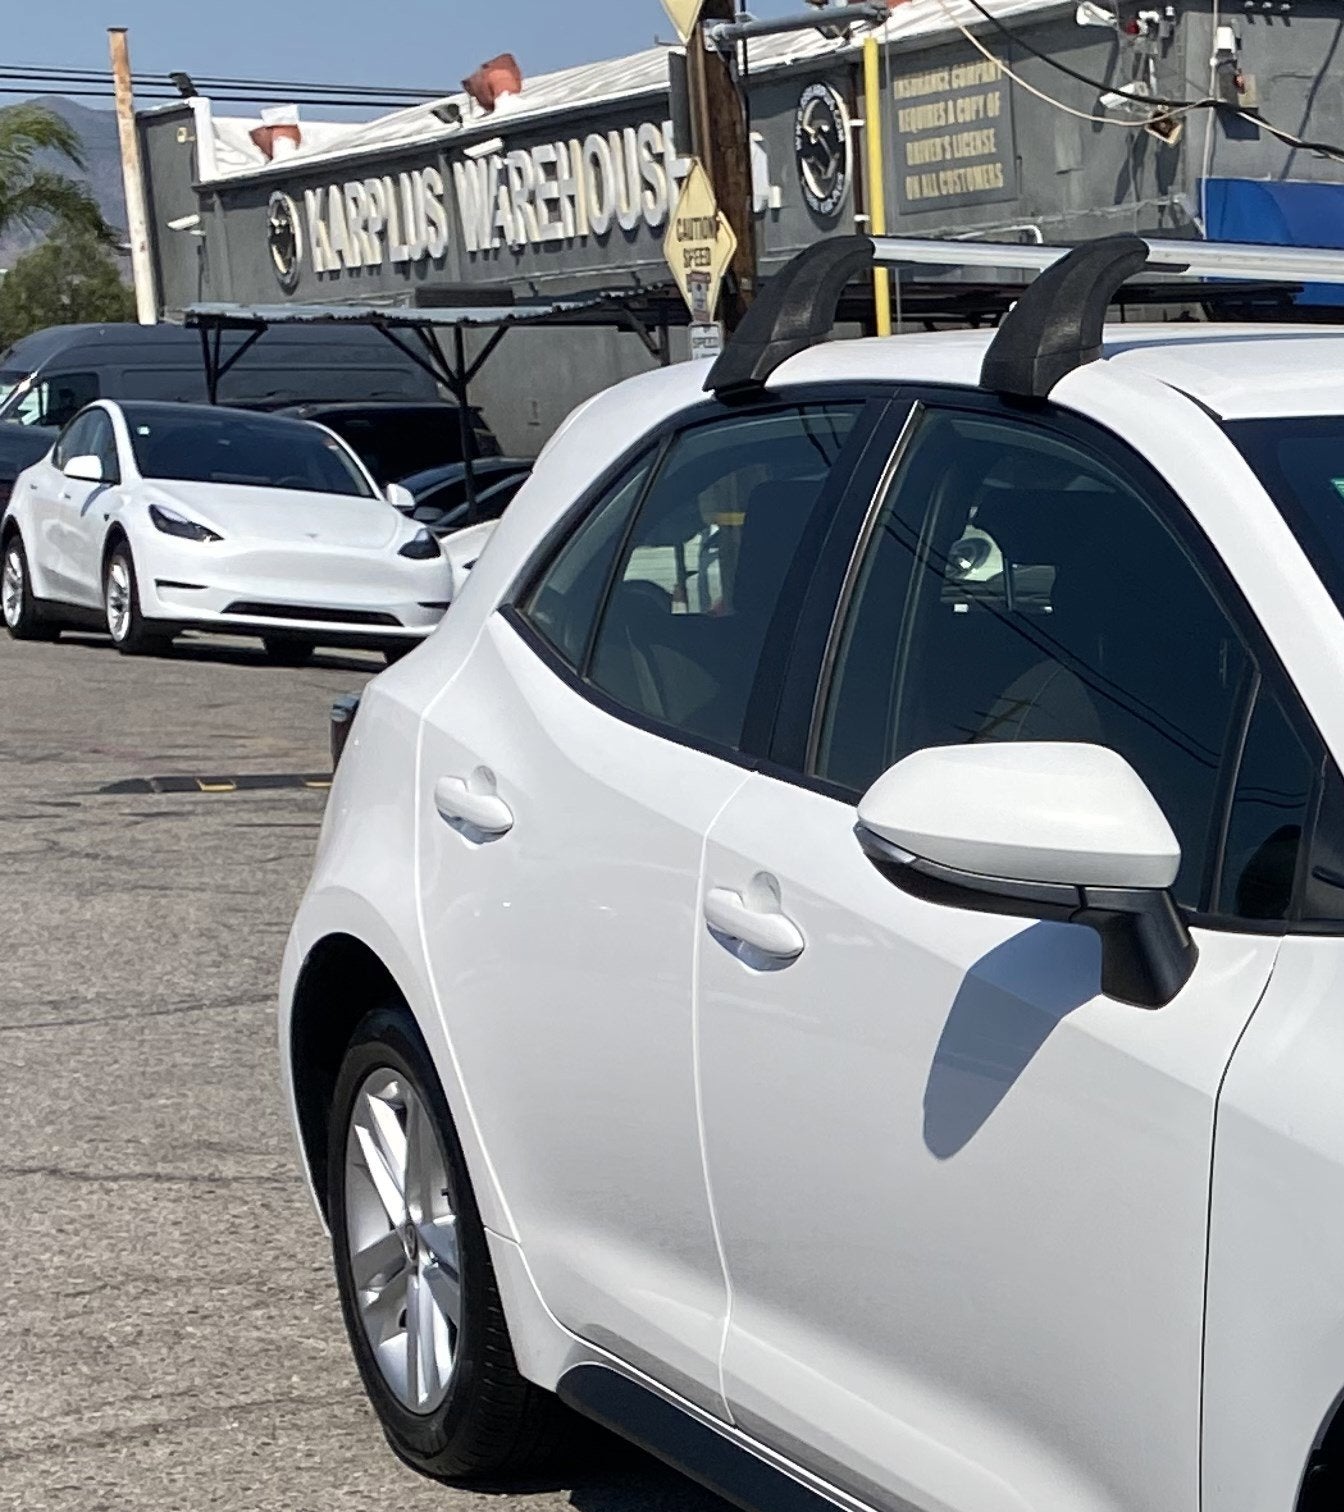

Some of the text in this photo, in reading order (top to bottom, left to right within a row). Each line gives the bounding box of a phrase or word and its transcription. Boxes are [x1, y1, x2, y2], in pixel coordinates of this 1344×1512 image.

[893, 59, 1002, 100] INSURANCE COMPANY
[898, 91, 1001, 134] REQUIRES A COPY OF
[952, 127, 997, 158] LICENSE
[905, 162, 1004, 200] ON ALL CUSTOMERS
[304, 165, 449, 273] KARPLUS
[676, 215, 718, 243] CAUTION
[683, 246, 712, 268] SPEED
